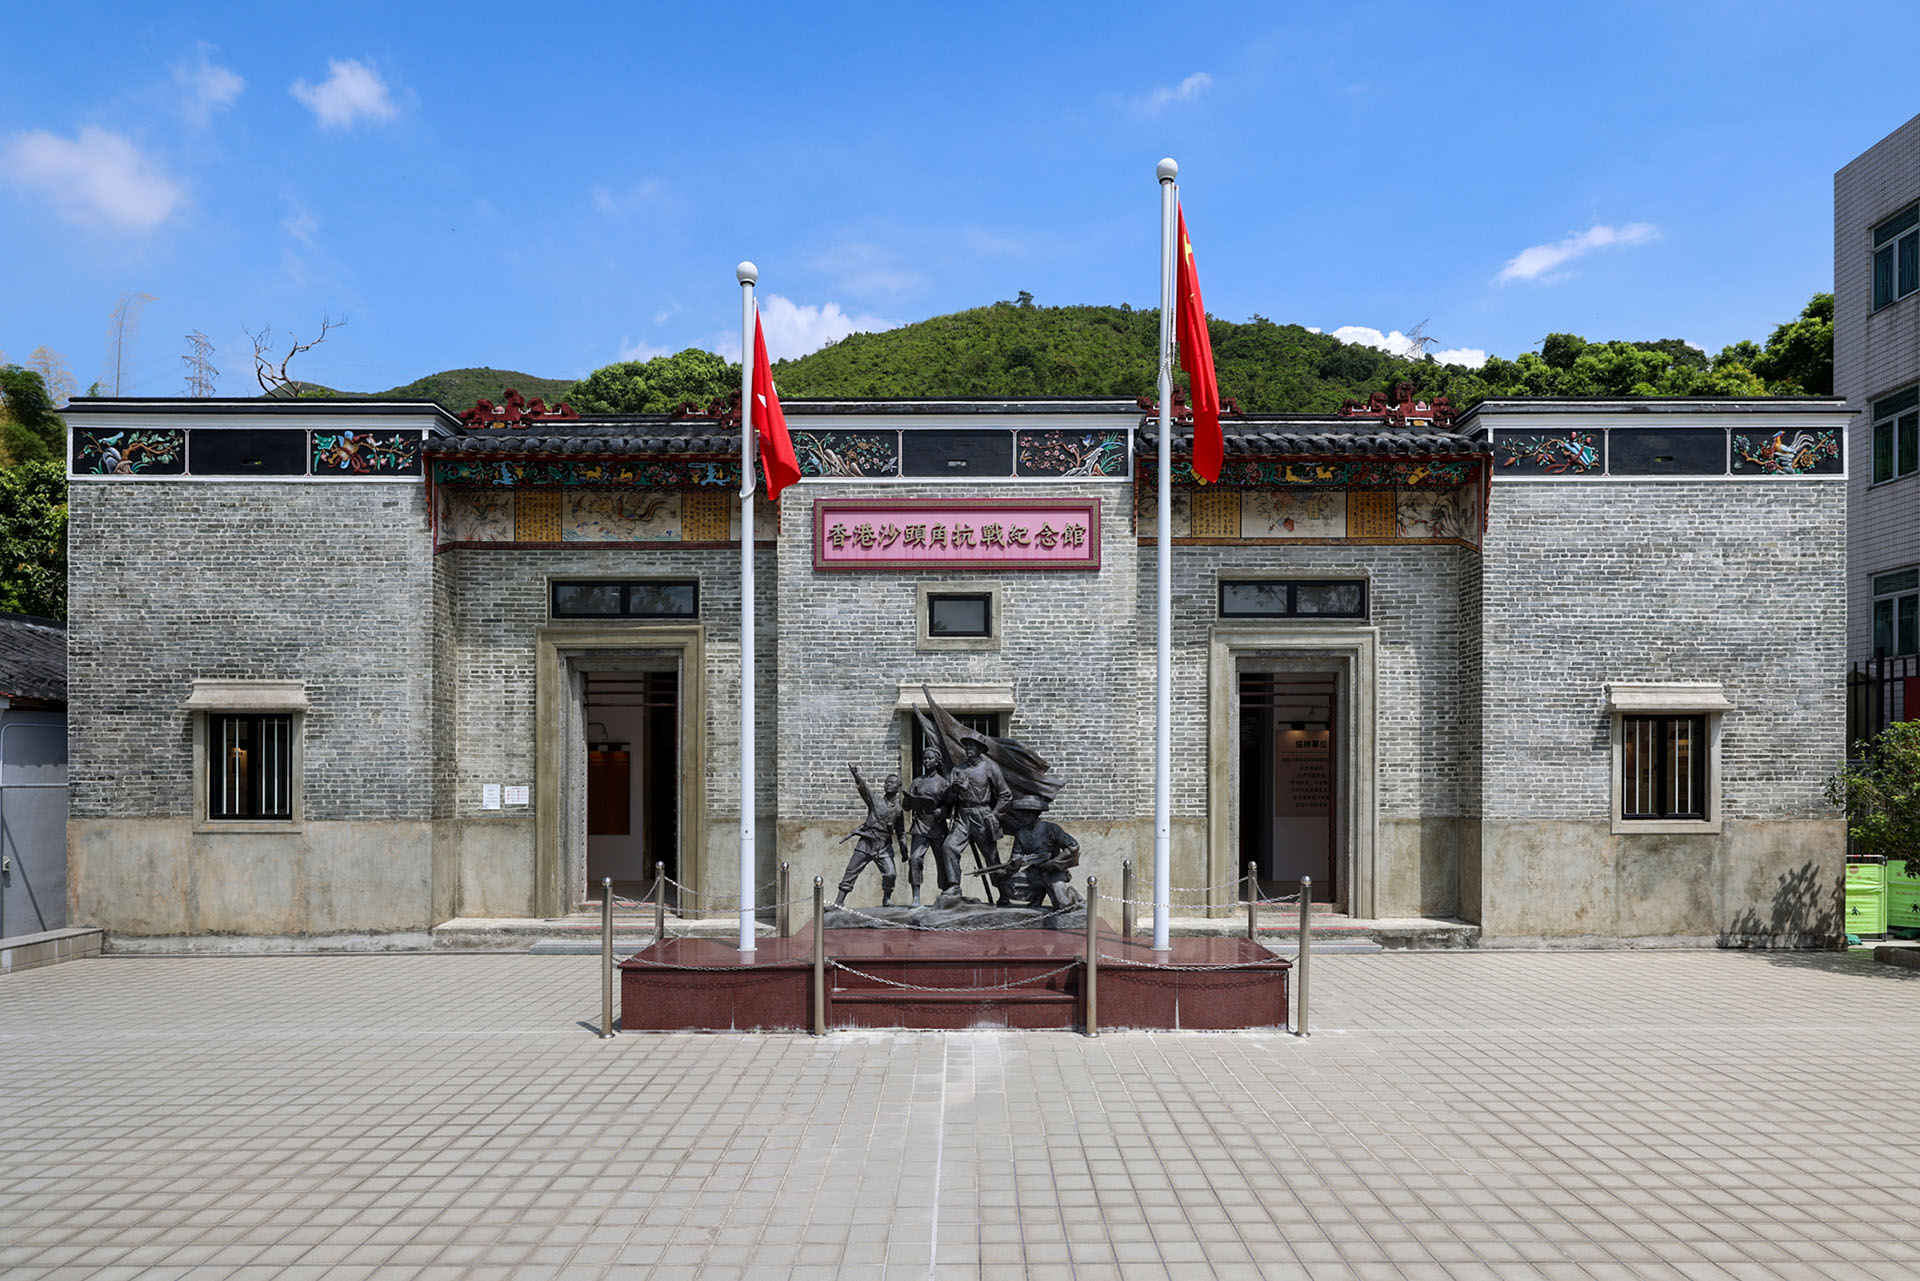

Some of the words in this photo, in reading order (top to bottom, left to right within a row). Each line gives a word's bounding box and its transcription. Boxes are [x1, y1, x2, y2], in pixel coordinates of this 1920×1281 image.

[827, 522, 1086, 549] 香港沙頭角抗戰紀念館
